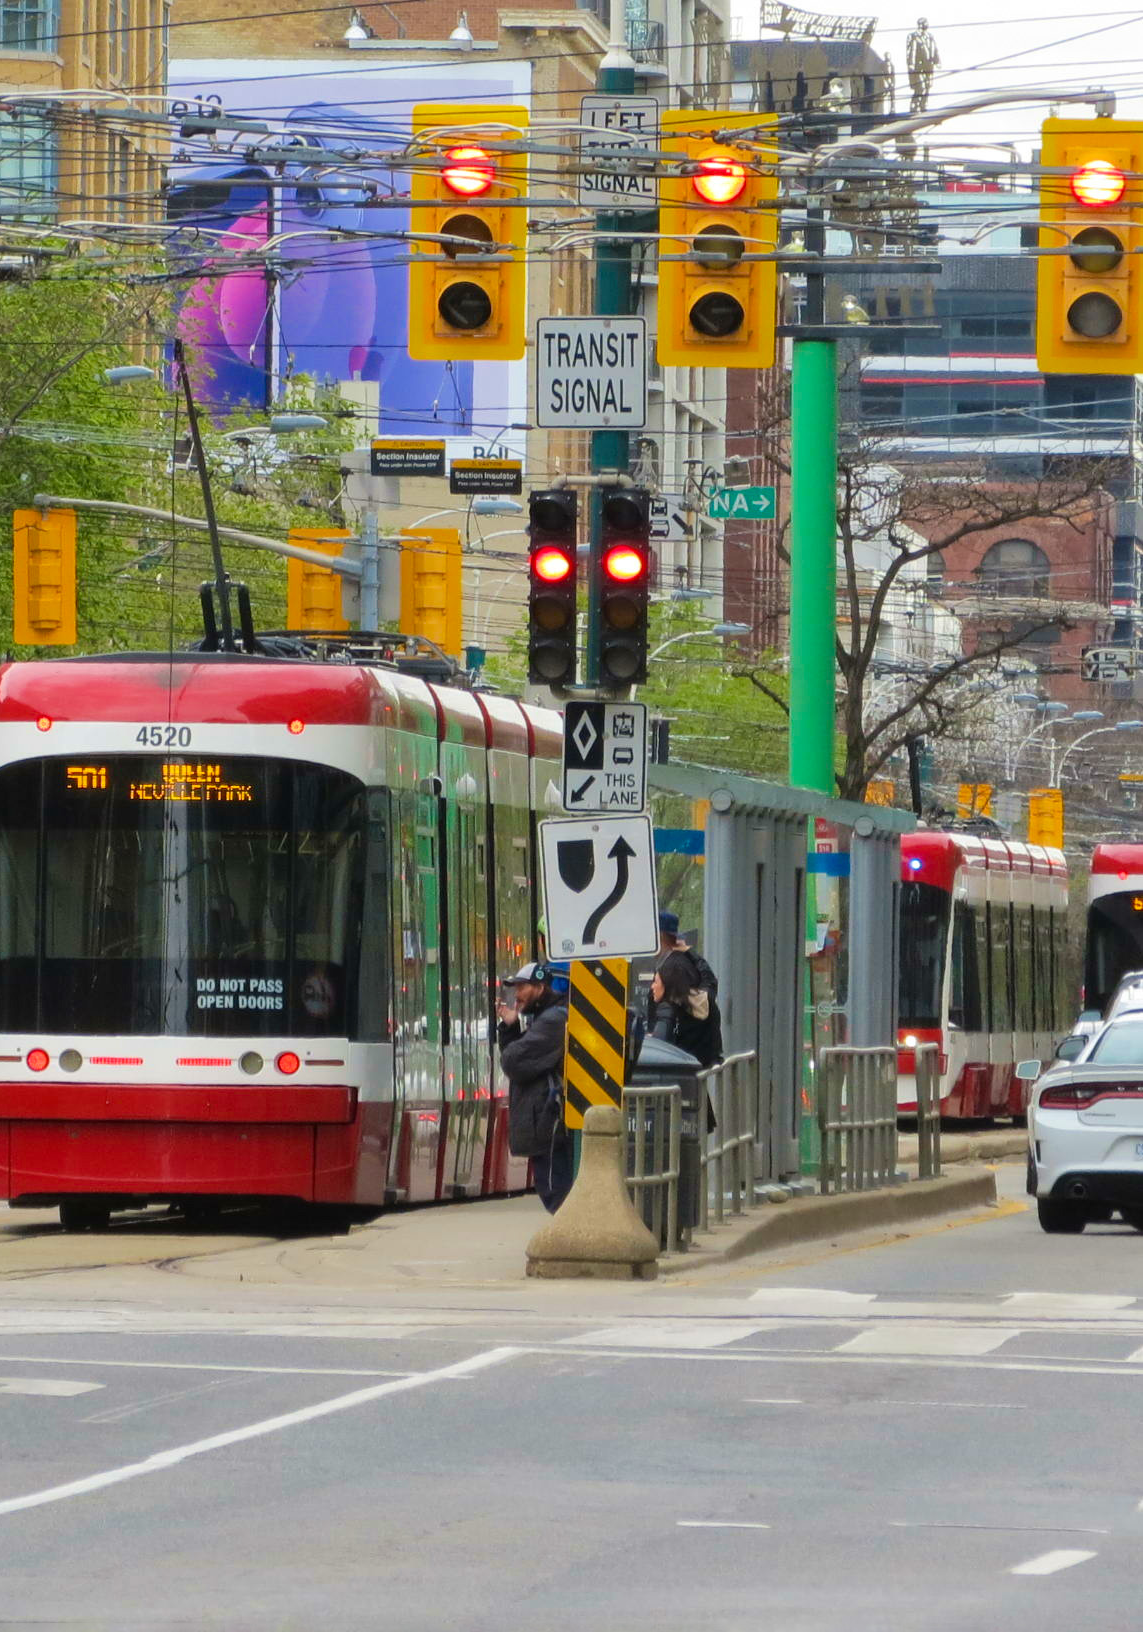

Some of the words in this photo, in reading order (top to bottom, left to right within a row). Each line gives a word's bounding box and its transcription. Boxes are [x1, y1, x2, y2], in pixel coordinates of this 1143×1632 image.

[584, 173, 653, 192] SIGNAL
[543, 332, 639, 368] TRANSIT
[550, 378, 633, 413] SIGNAL
[376, 452, 405, 461] Section
[406, 452, 440, 461] Insulator
[455, 471, 483, 480] Section
[484, 471, 517, 480] Insulator
[135, 726, 192, 747] 4520
[162, 764, 221, 783] QUEEN
[604, 773, 636, 788] THIS
[130, 783, 202, 800] NEVILLE
[206, 784, 253, 801] PARK
[599, 790, 639, 805] LANE
[196, 978, 216, 992] DO
[219, 978, 246, 993] NOT
[249, 979, 284, 994] PASS
[197, 995, 234, 1009] OPEN
[238, 995, 284, 1010] DOORS
